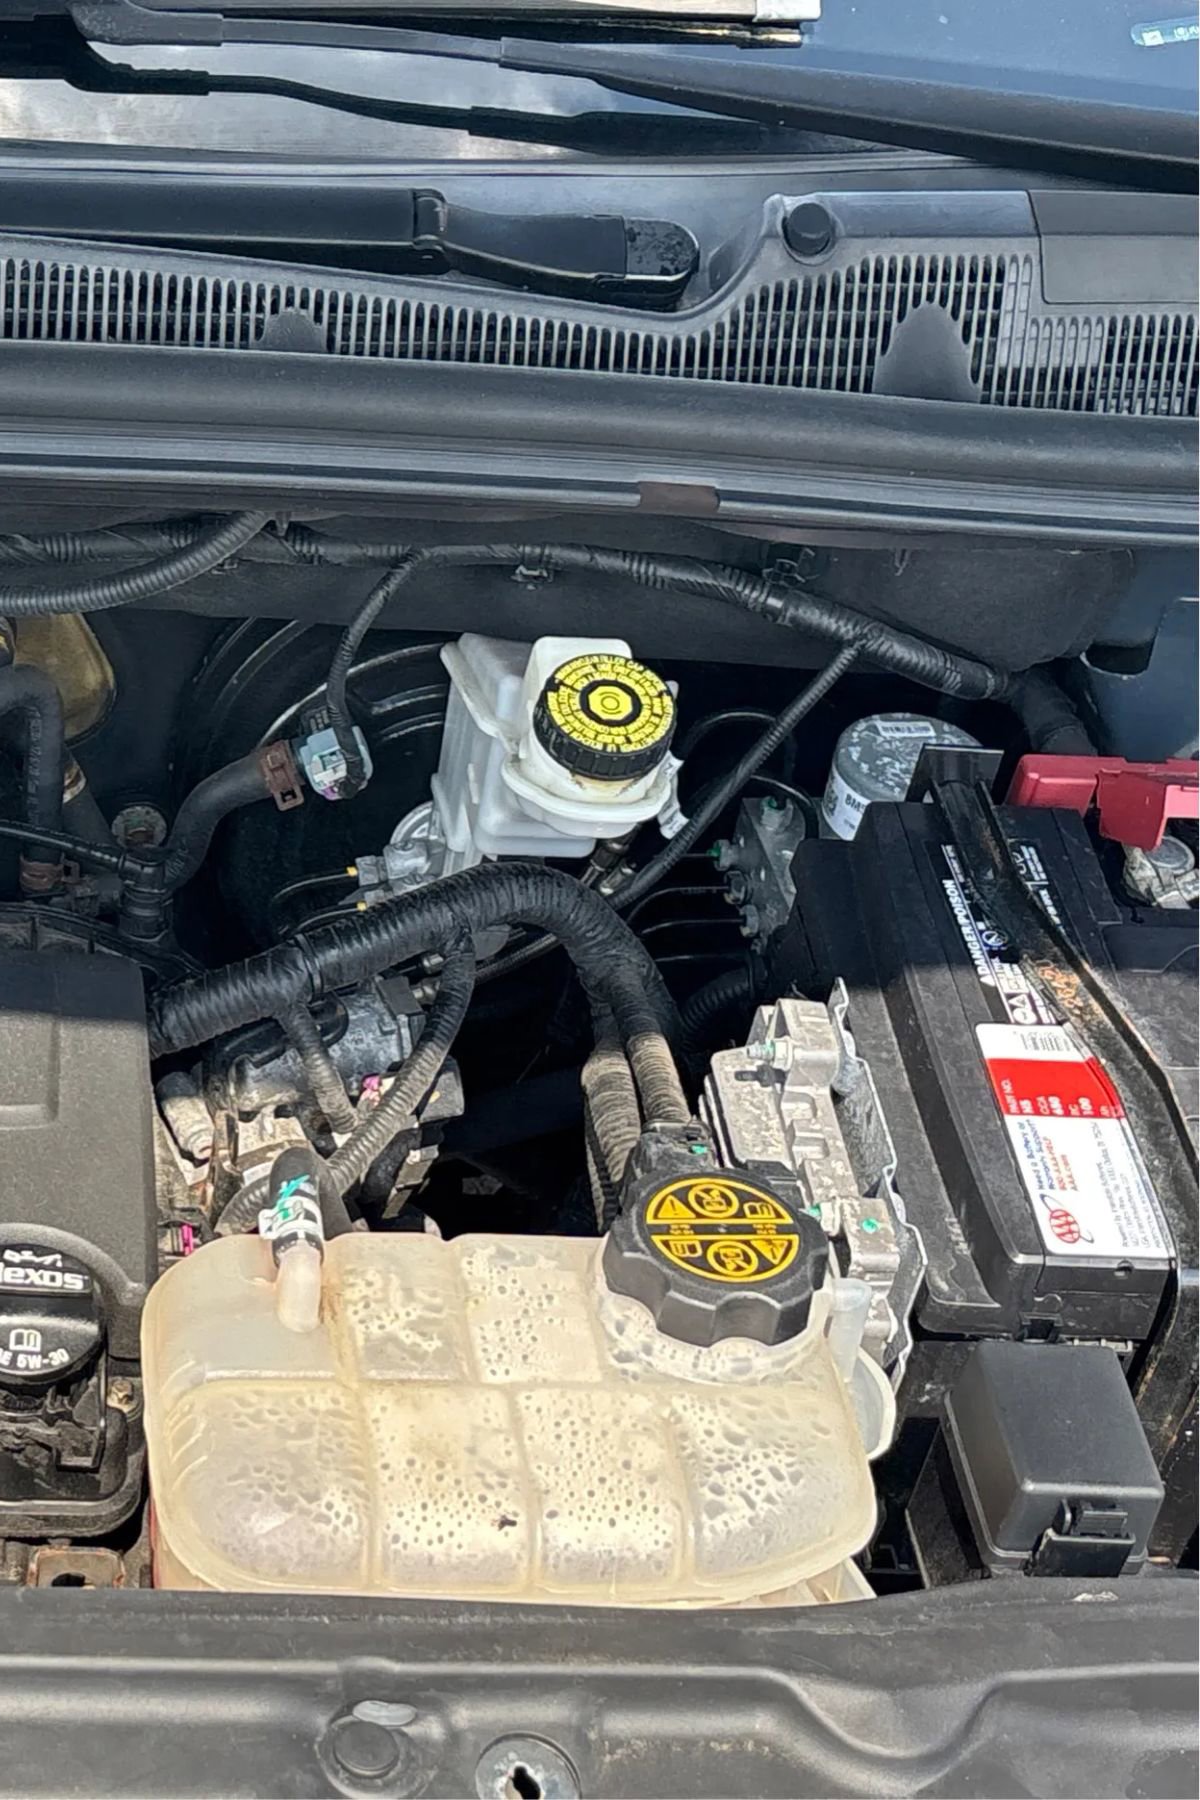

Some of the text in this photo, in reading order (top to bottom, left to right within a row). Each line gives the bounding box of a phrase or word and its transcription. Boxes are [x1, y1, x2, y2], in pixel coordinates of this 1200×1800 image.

[626, 660, 645, 671] CAP
[1036, 1096, 1050, 1115] CCA
[1078, 1097, 1094, 1115] 100
[1060, 1154, 1079, 1191] AAA.com
[1051, 1210, 1080, 1240] AAA
[16, 1348, 70, 1369] 5W-30
